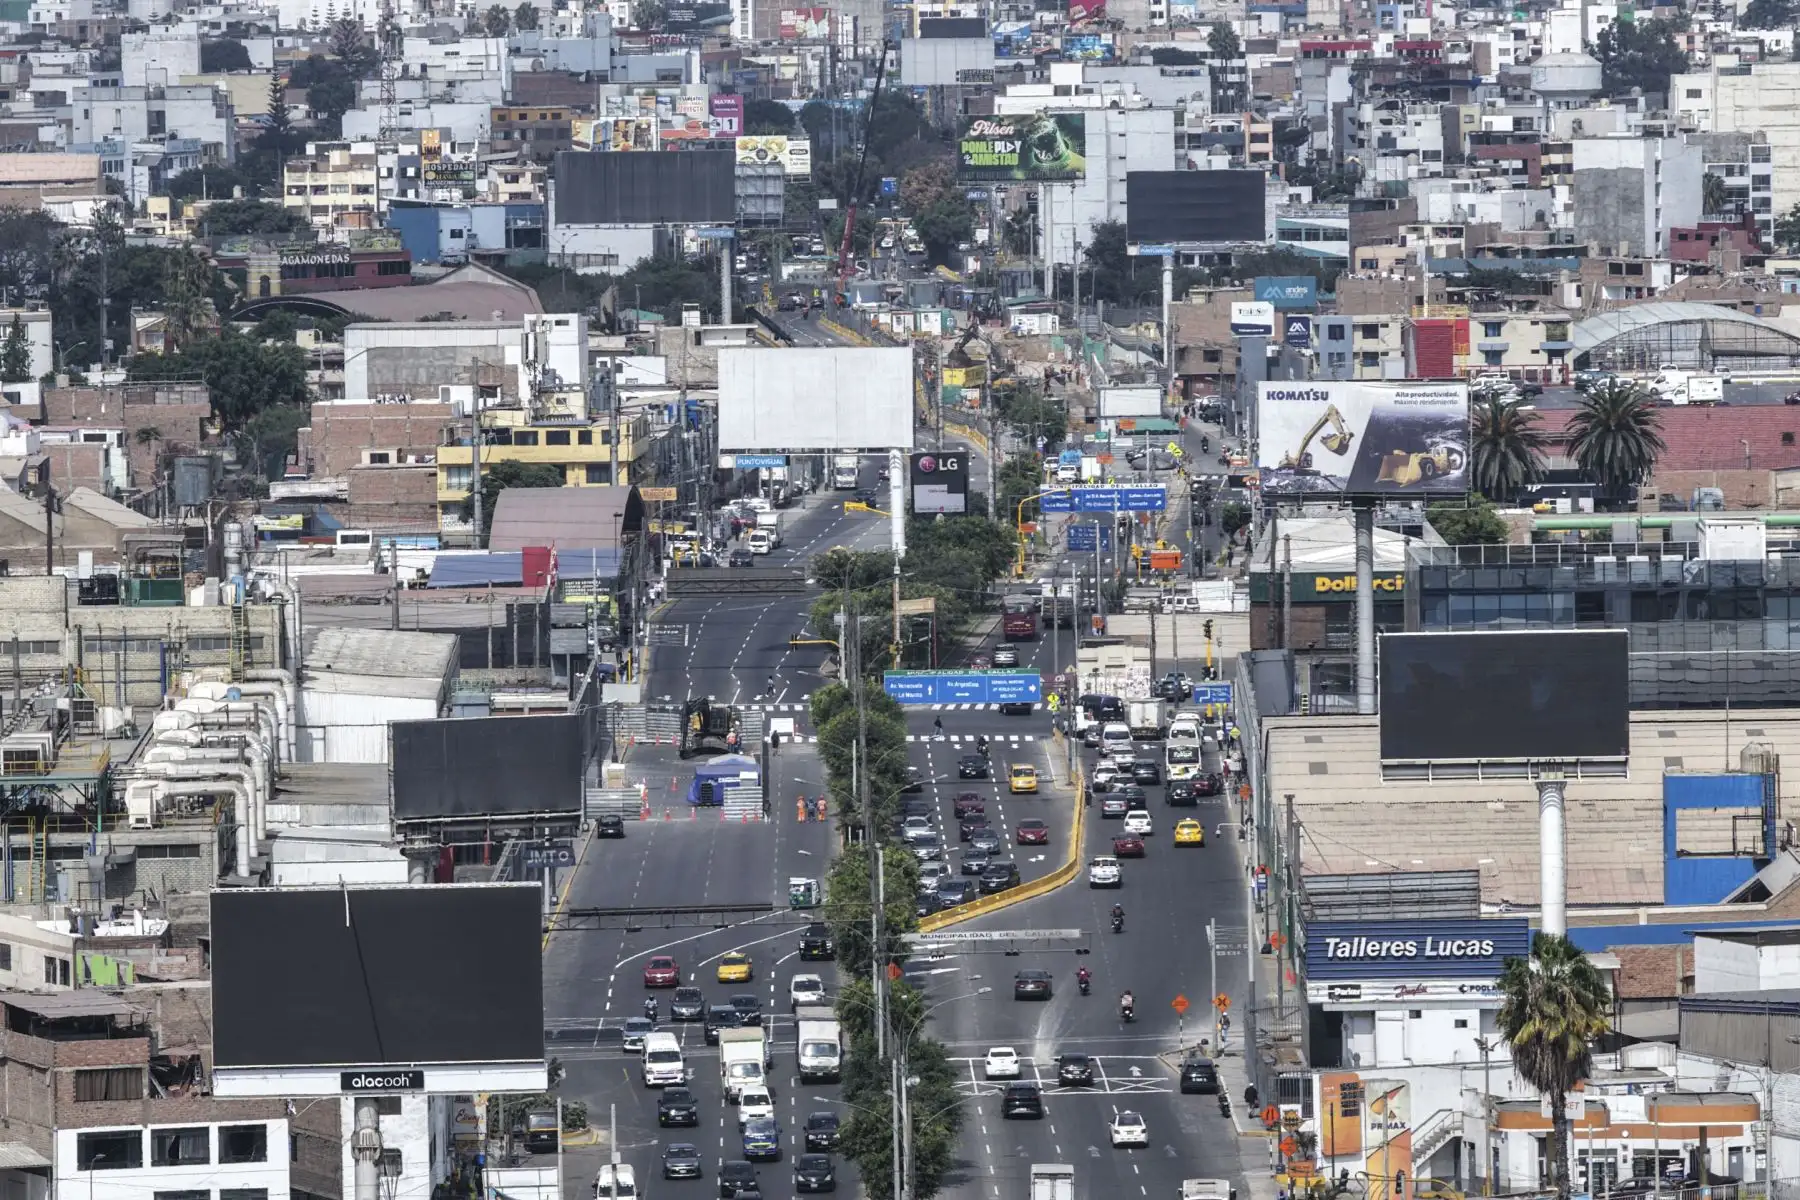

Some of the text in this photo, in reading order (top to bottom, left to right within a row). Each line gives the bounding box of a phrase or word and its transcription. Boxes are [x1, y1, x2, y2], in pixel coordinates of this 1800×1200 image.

[727, 118, 733, 130] 1
[969, 119, 1015, 136] Pilsen
[961, 140, 994, 153] PONLE
[972, 153, 1019, 166] AMISTAD
[424, 163, 474, 171] HOSPEDAJE
[281, 254, 350, 265] AGAMONEDAS
[1266, 389, 1329, 401] KOMATSU
[939, 458, 958, 471] LG
[1315, 574, 1405, 592] Dollrci
[1325, 936, 1494, 957] Talleres Lucas
[1333, 987, 1361, 996] Parker
[352, 1073, 409, 1087] alacooh
[1370, 1121, 1406, 1131] PRMAX
